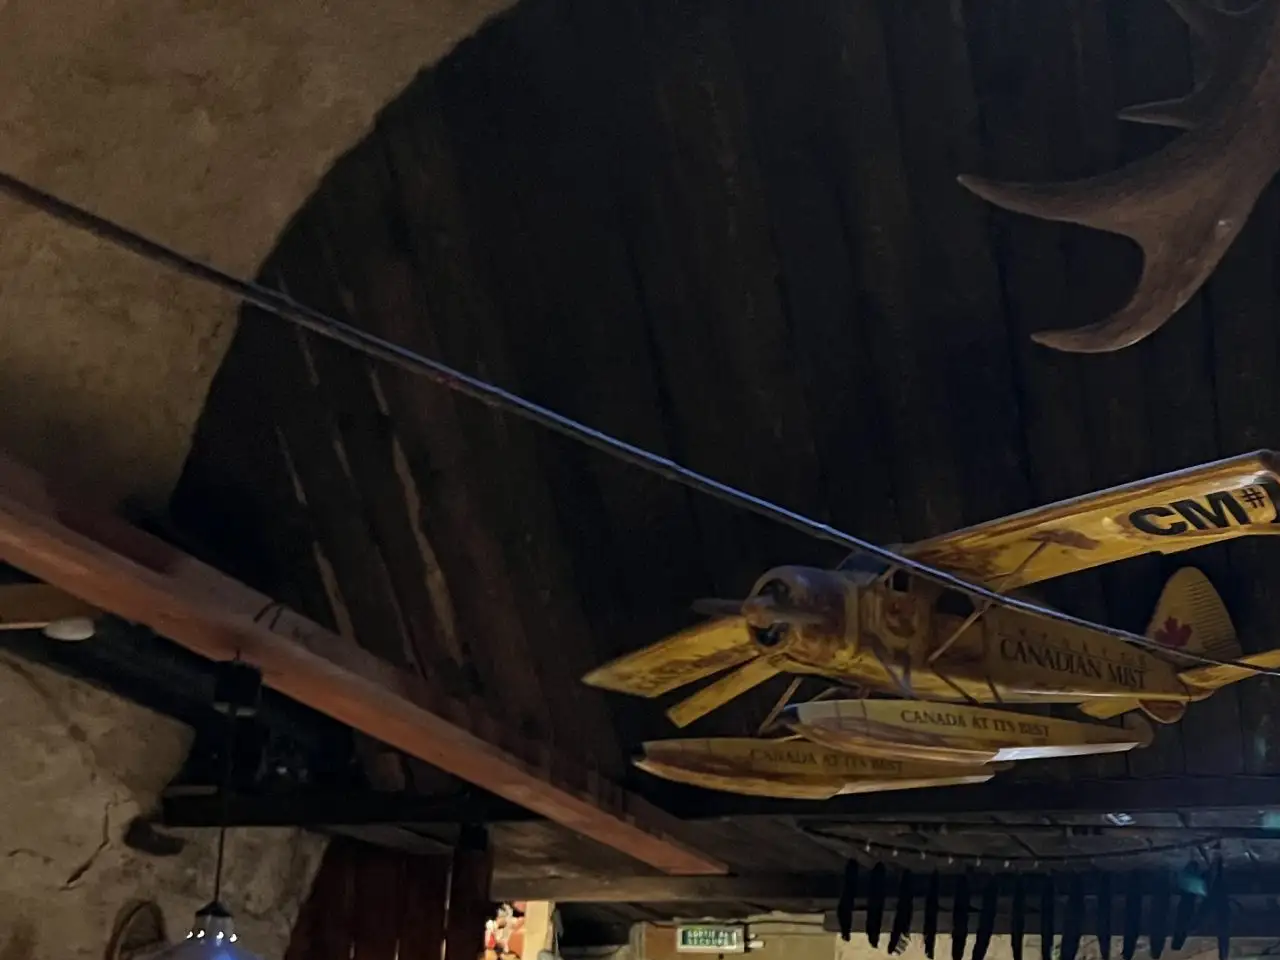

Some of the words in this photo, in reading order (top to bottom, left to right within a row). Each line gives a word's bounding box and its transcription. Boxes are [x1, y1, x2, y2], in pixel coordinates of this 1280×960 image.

[1000, 638, 1102, 680] CANADIAN
[1106, 662, 1147, 690] MIST
[900, 709, 967, 729] CANADA
[971, 715, 989, 731] AT
[1017, 721, 1050, 738] BEST
